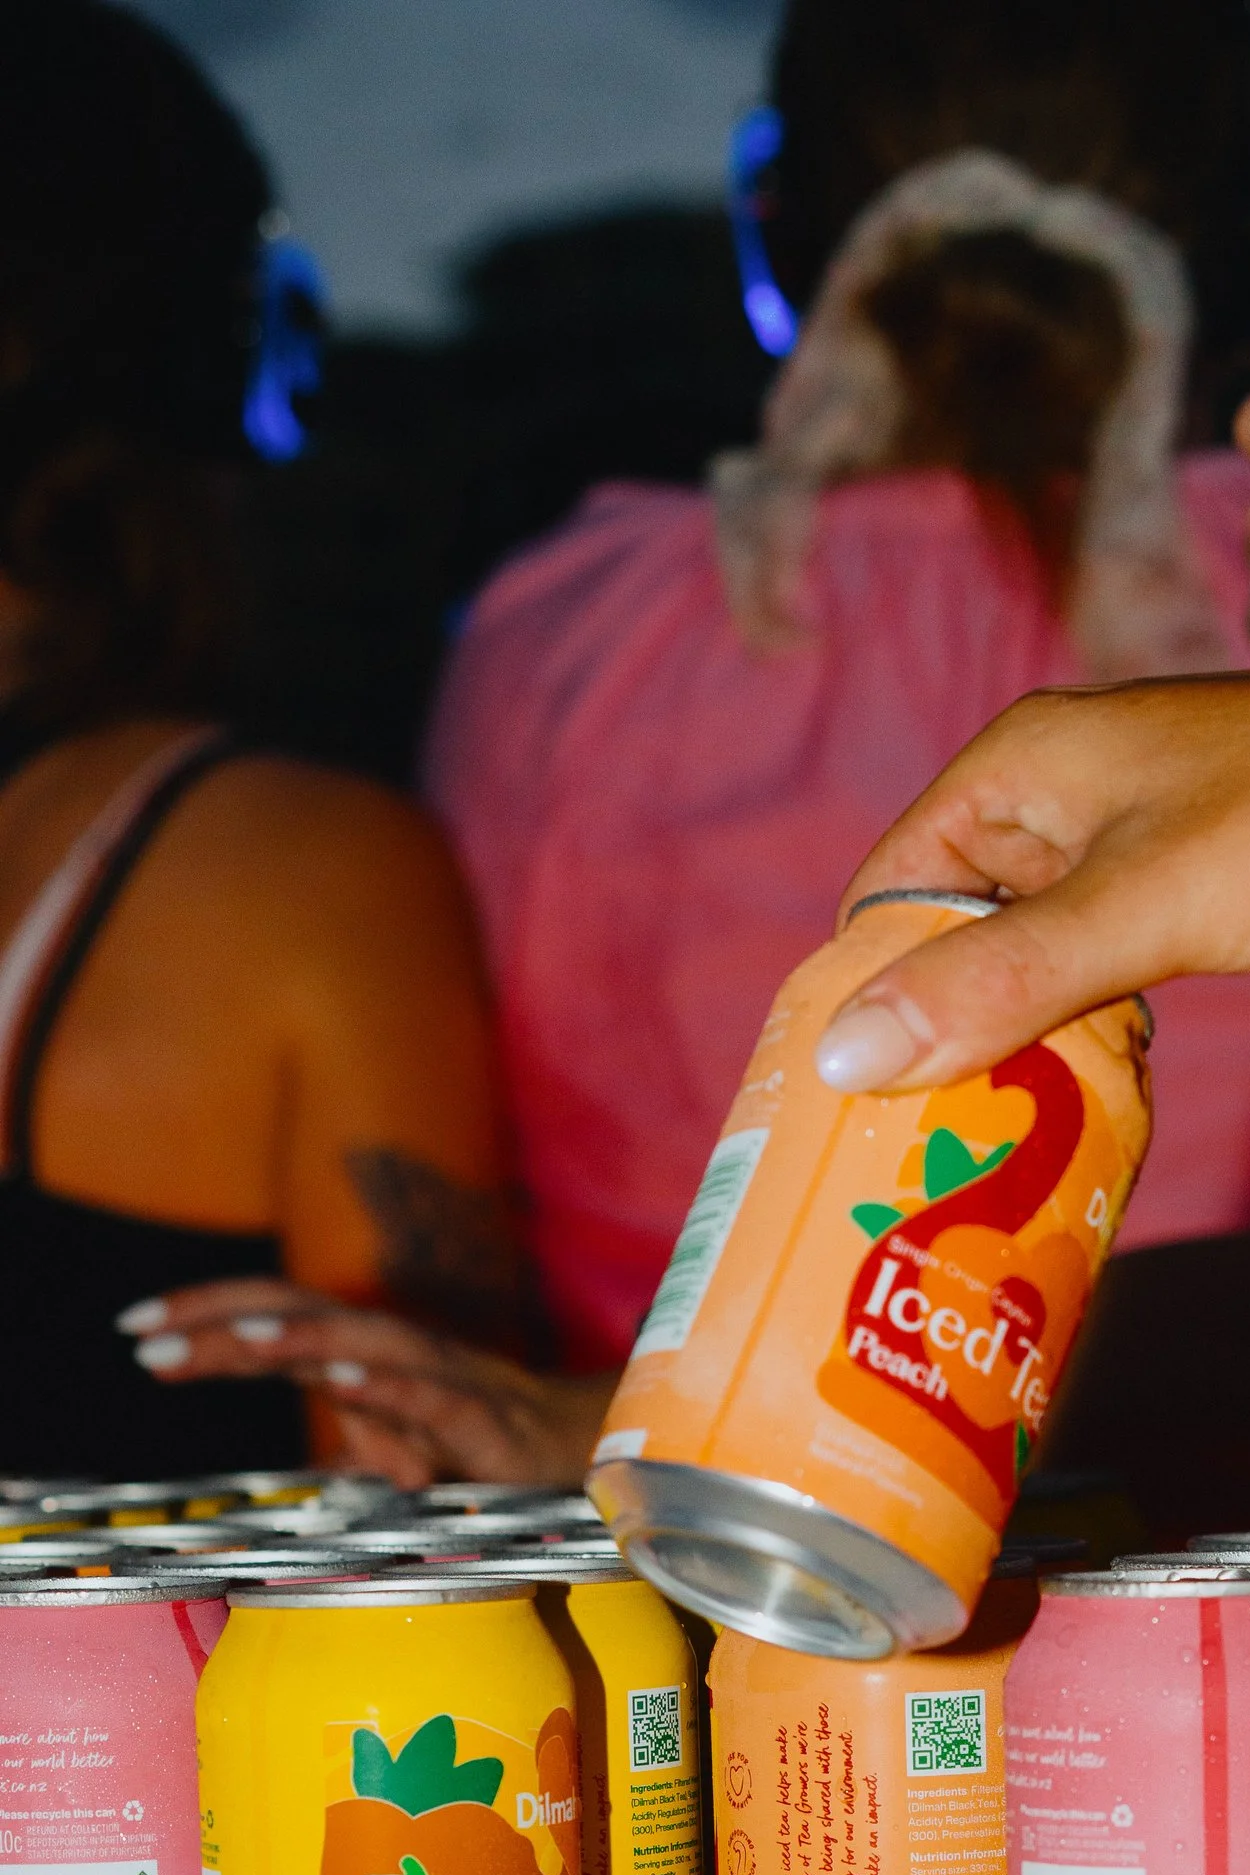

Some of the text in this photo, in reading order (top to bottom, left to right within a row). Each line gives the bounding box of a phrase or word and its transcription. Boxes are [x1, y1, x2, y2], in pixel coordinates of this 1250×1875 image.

[864, 1257, 1010, 1378] Iced
[848, 1325, 948, 1401] Peach
[814, 1702, 831, 1740] those
[37, 1728, 109, 1746] about how
[776, 1725, 787, 1764] make
[793, 1721, 808, 1755] we're
[4, 1750, 115, 1768] our world better
[815, 1747, 832, 1774] with
[838, 1730, 854, 1814] environment.
[776, 1771, 791, 1805] helps
[795, 1762, 812, 1813] Growers
[862, 1773, 881, 1824] impact.
[31, 1808, 116, 1822] recycle this can
[814, 1781, 834, 1827] shared
[949, 1800, 975, 1810] Black
[71, 1822, 120, 1834] COLLECTION
[632, 1812, 656, 1821] Acidity
[778, 1810, 790, 1836] tea
[908, 1814, 996, 1827] Acidity Regulators
[798, 1820, 811, 1847] Tea
[846, 1820, 854, 1841] our
[870, 1832, 878, 1848] an
[942, 1829, 1000, 1840] Preservative
[634, 1845, 670, 1856] Nutrition
[777, 1842, 790, 1871] iced
[798, 1854, 811, 1867] of
[819, 1833, 838, 1872] being
[841, 1846, 856, 1865] for
[910, 1852, 960, 1862] Nutrition
[634, 1859, 660, 1870] Serving
